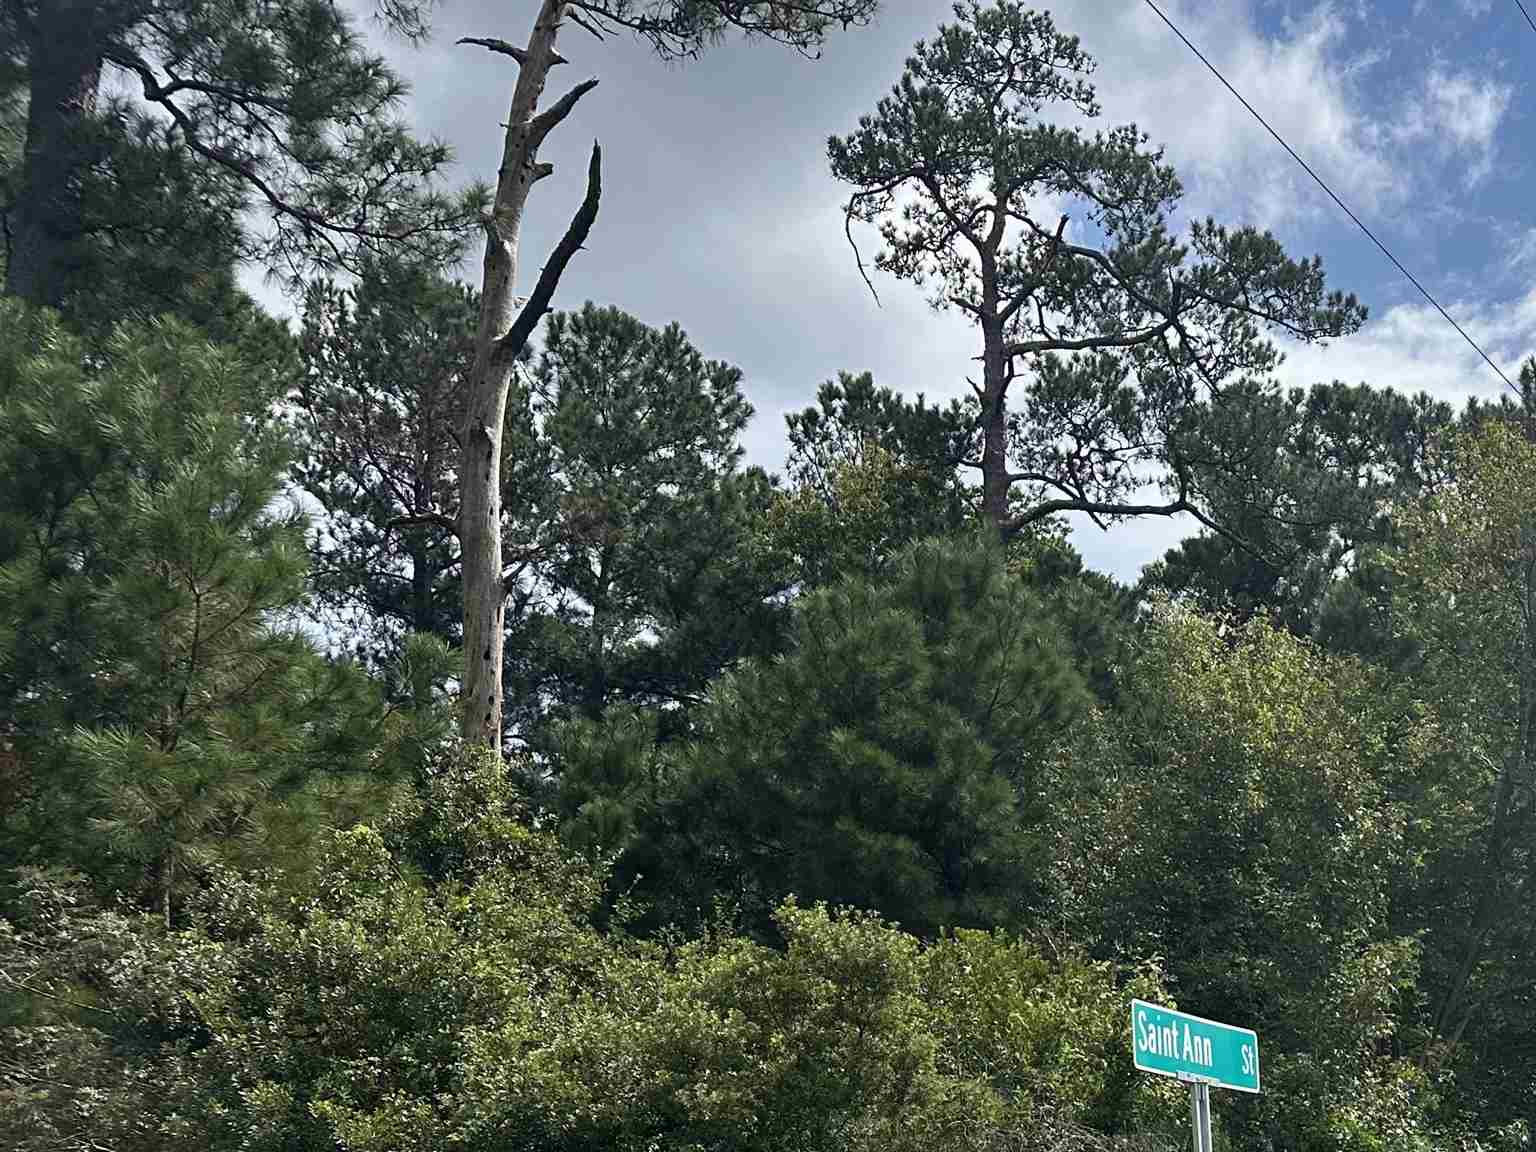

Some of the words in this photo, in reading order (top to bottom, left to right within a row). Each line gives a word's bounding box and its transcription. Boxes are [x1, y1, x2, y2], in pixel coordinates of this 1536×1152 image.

[1138, 1010, 1179, 1059] Saint
[1183, 1023, 1213, 1067] Ann
[1241, 1044, 1255, 1075] St
